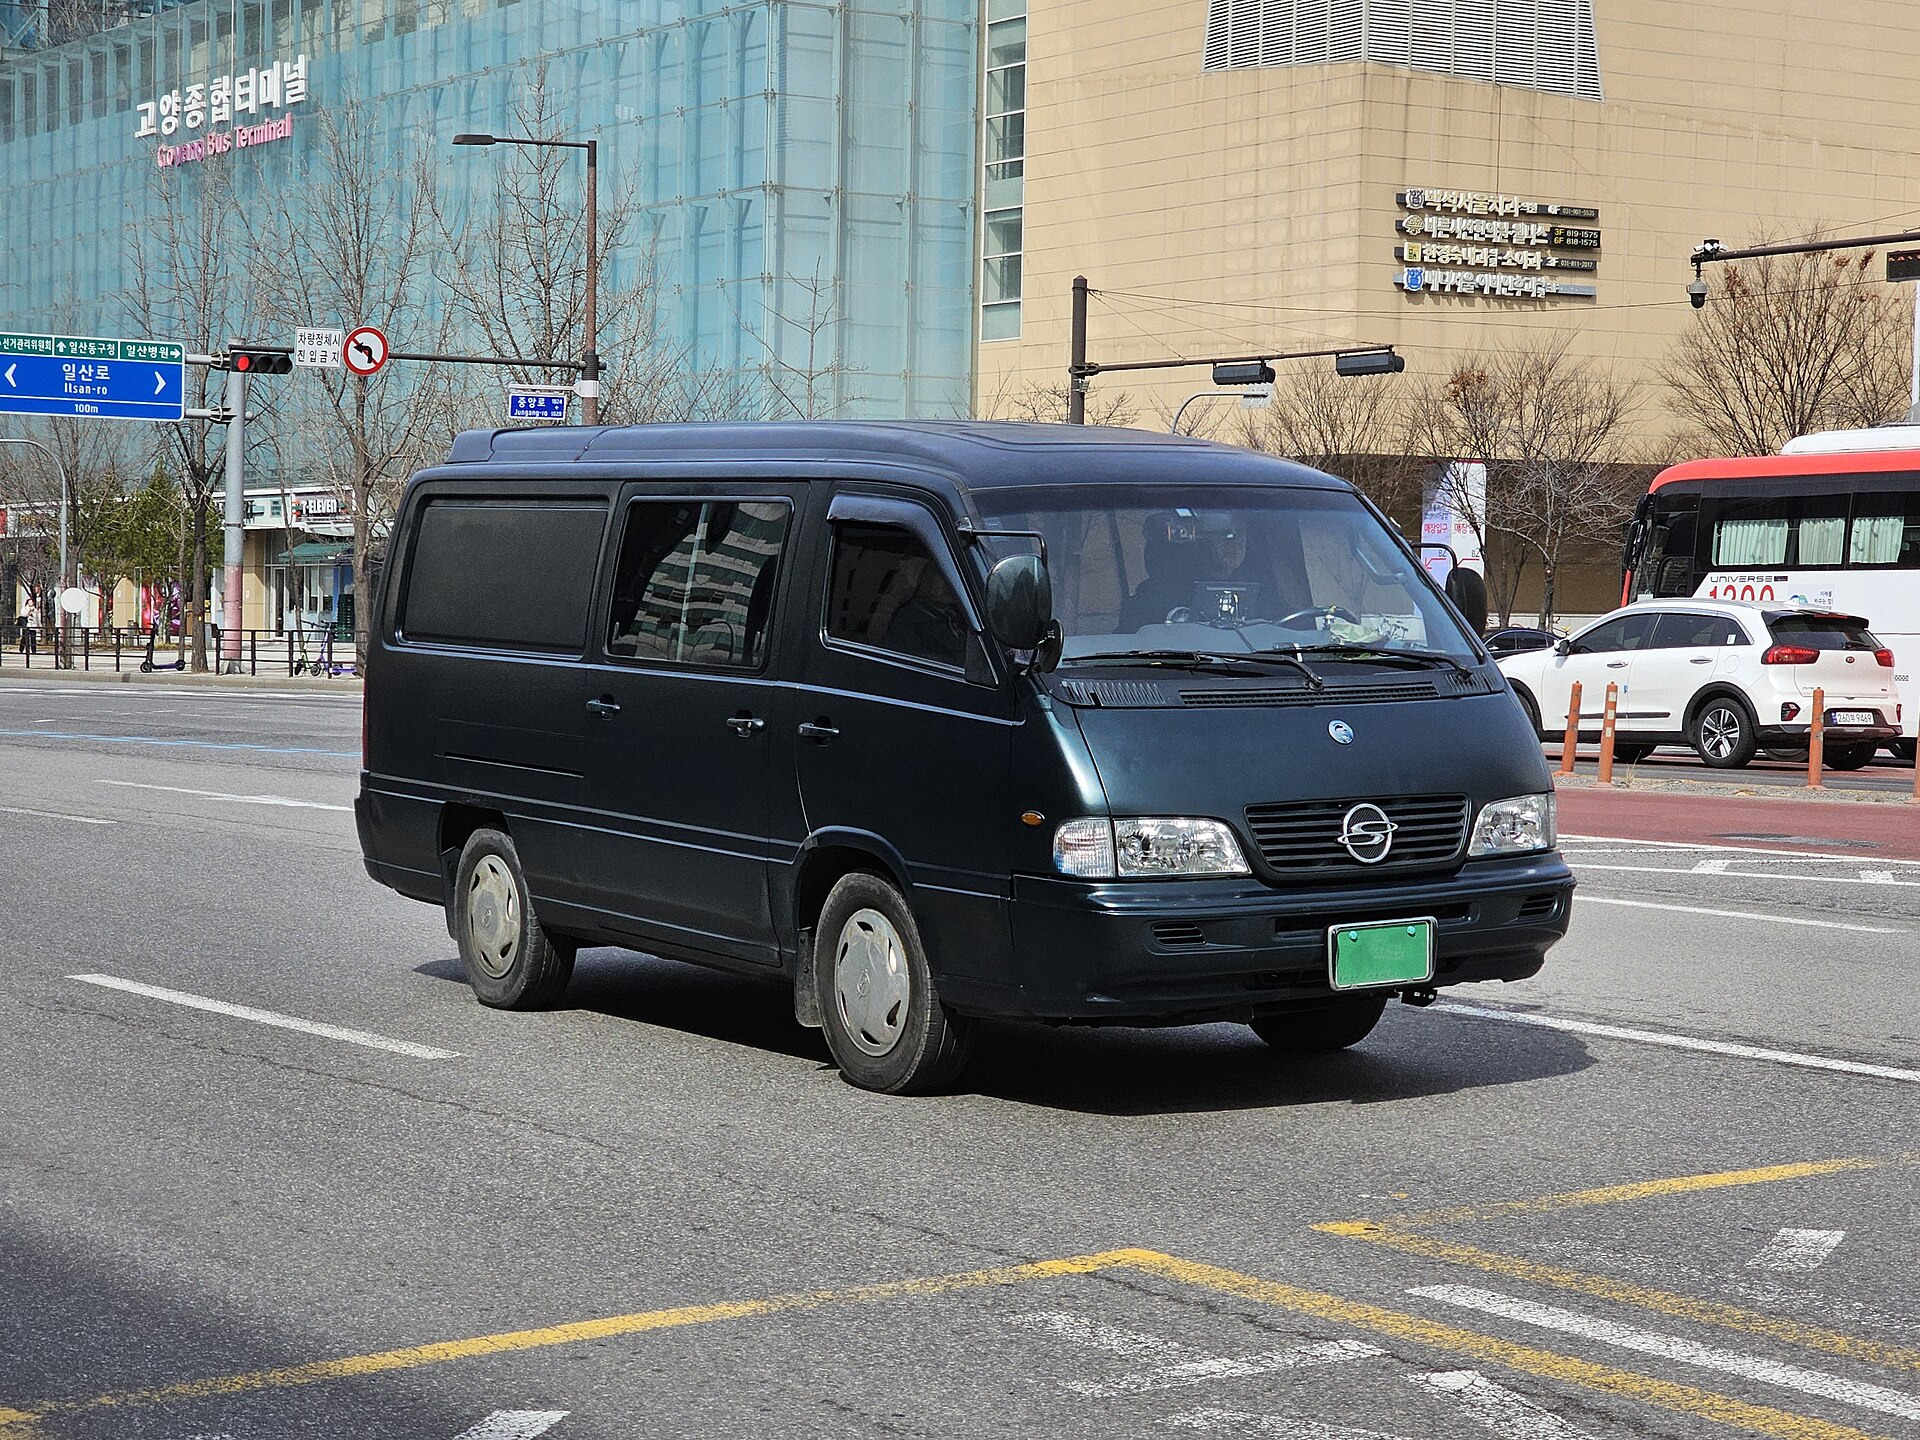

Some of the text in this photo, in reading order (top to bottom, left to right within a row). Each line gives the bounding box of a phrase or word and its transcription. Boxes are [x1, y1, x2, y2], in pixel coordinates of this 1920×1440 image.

[134, 53, 307, 138] 고양종합터미널
[157, 111, 293, 168] Goyang Bus Terminal
[1554, 228, 1599, 239] 3F 819-1575
[1566, 238, 1598, 247] 818-1575
[298, 332, 340, 346] 차량정체시
[2, 337, 169, 359] 선거관리위원회 일산동구청 일산병원
[62, 363, 111, 382] 일산로
[64, 382, 108, 396] Ilsan-ro
[74, 403, 99, 414] 100m
[517, 396, 546, 409] 중앙로
[514, 408, 549, 418] Jungang-ro
[1710, 575, 1773, 583] UNIVERSE
